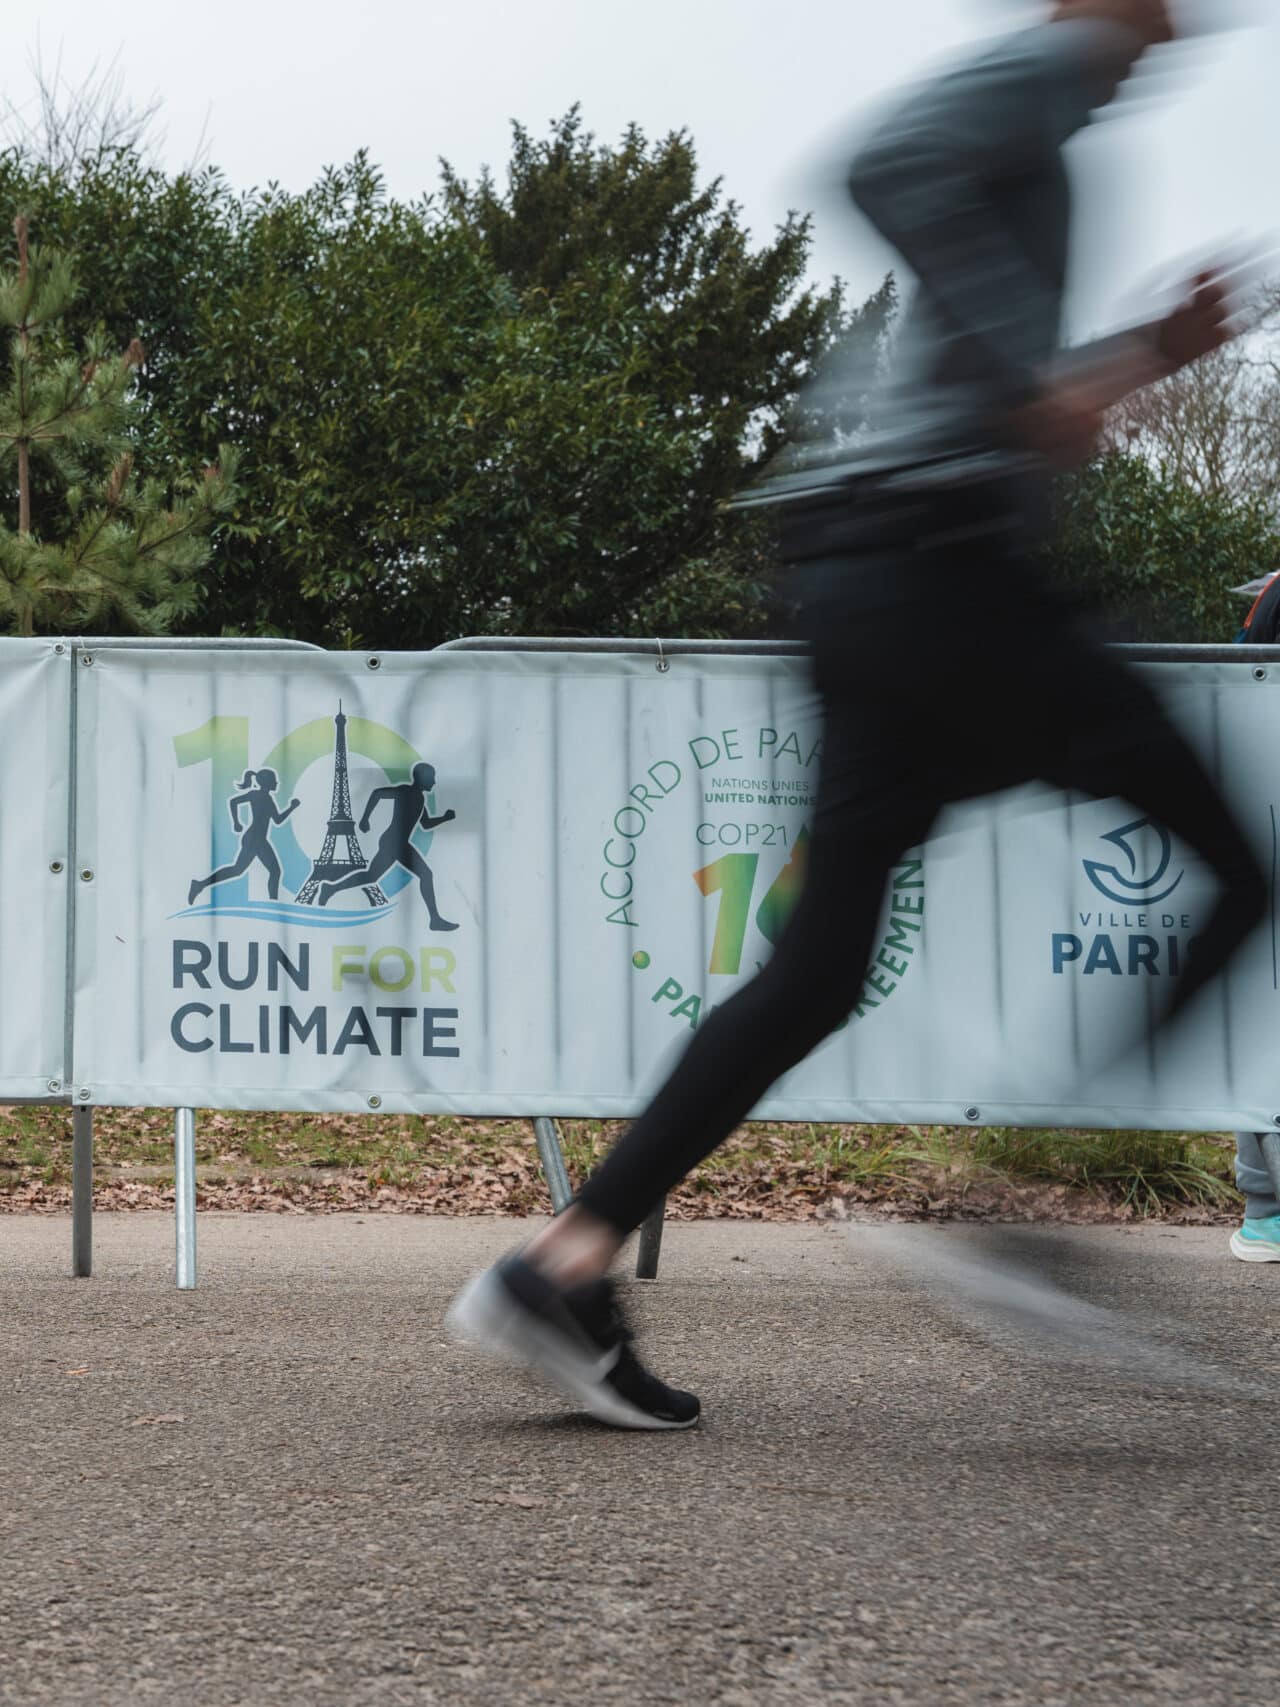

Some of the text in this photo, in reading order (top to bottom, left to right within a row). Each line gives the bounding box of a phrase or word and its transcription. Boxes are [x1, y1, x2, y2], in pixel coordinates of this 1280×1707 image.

[704, 793, 818, 807] UNITED NATIONS
[712, 778, 809, 792] NATIONS UNIES
[600, 760, 682, 928] ACCORD
[688, 729, 743, 769] DE
[696, 822, 788, 847] COP21
[1079, 912, 1191, 929] VILLE DE
[173, 939, 457, 994] RUN FOR
[651, 976, 718, 1030] PA
[170, 1002, 461, 1058] CLIMATE
